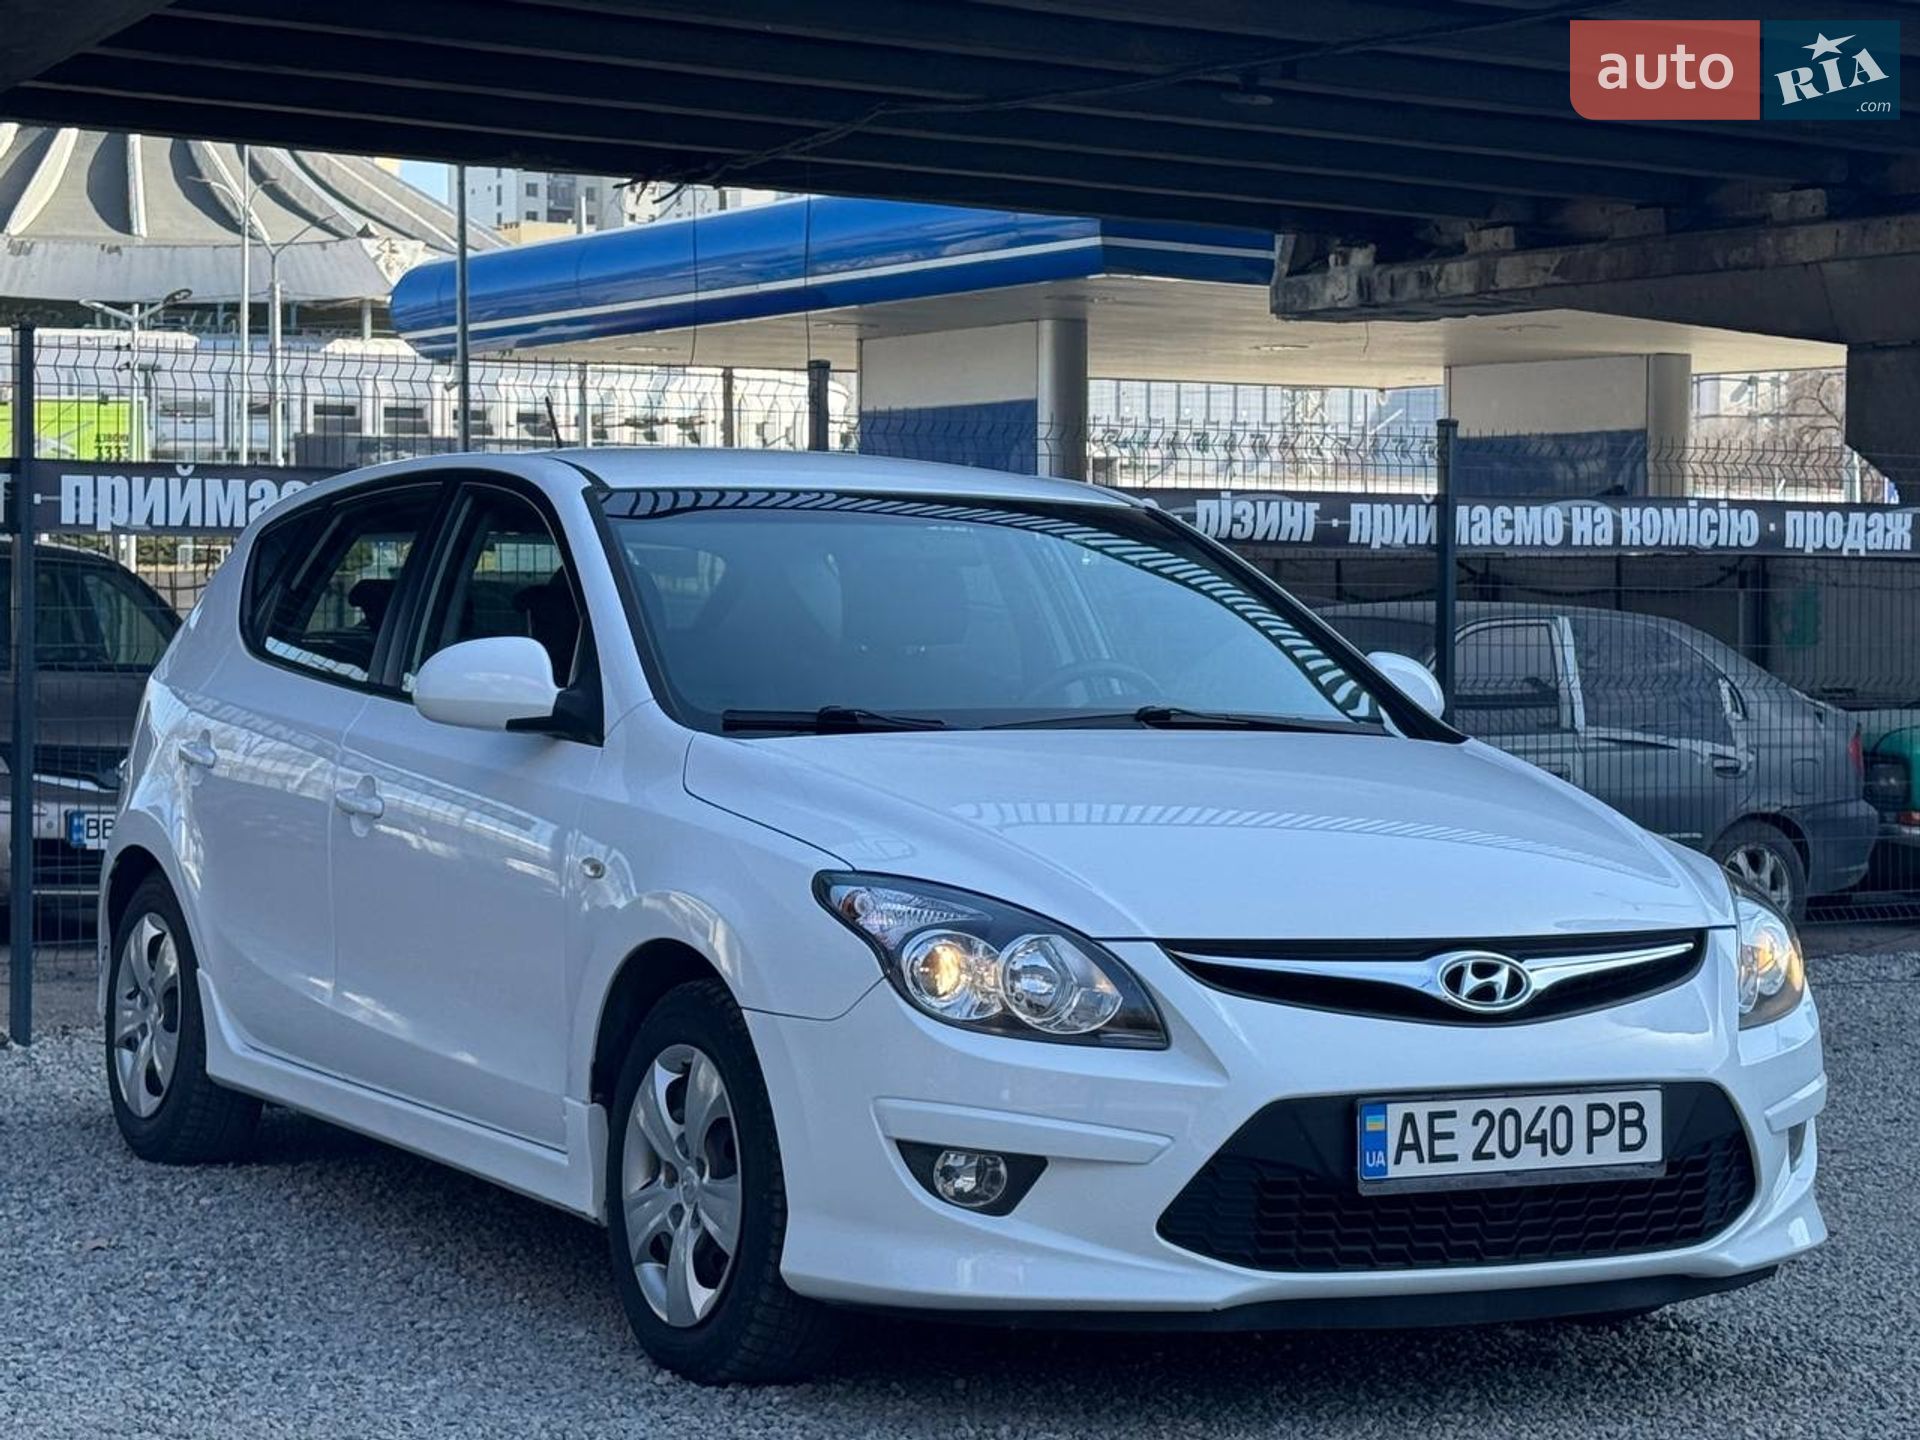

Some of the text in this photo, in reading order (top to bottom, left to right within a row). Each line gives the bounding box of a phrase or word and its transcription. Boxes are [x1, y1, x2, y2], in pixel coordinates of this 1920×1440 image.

[60, 465, 320, 531] прийма
[1572, 506, 1614, 546] на
[1621, 500, 1759, 548] комісію
[1785, 510, 1912, 556] продаж
[1366, 1150, 1385, 1167] UA
[1394, 1101, 1648, 1165] AE 2040 PB
